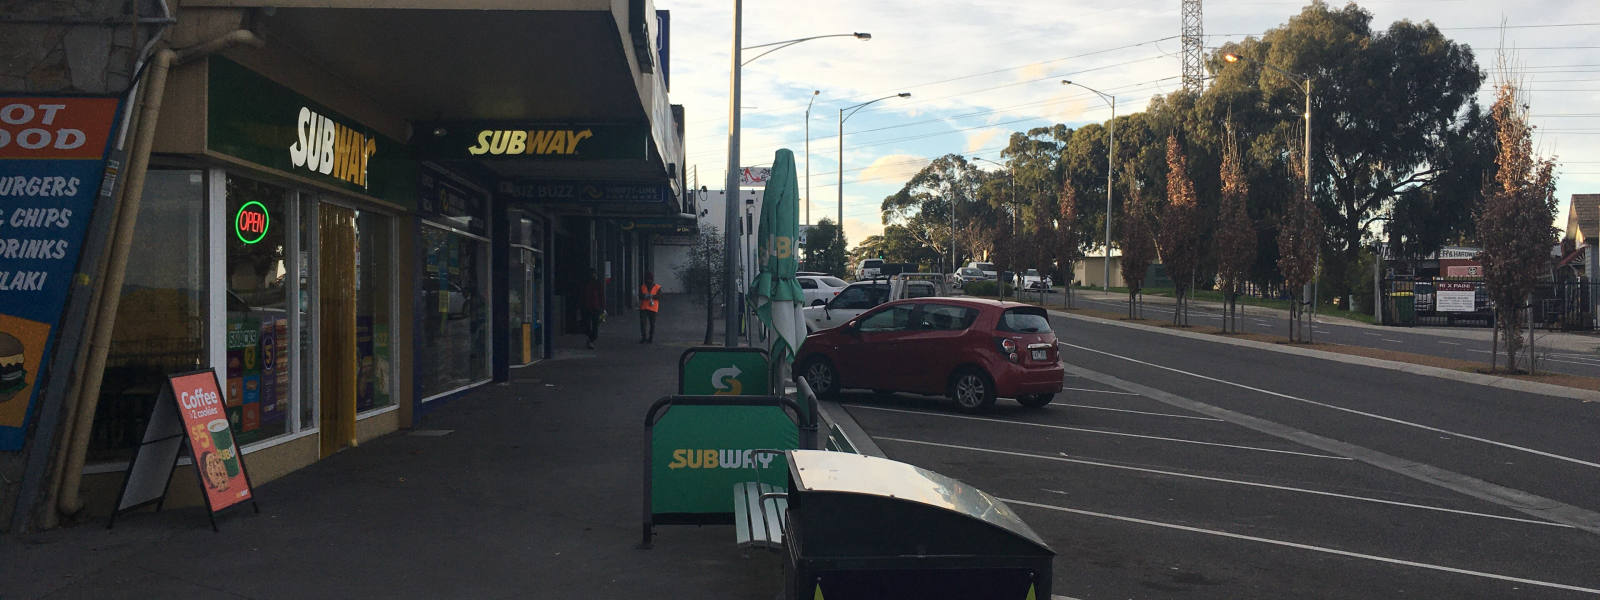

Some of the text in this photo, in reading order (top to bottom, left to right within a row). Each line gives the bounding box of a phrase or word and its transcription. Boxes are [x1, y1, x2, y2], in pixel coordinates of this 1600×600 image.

[289, 106, 377, 187] SUBWAY
[468, 129, 594, 156] SUBWAY
[10, 207, 73, 229] CHIPS
[239, 210, 265, 234] OPEN
[181, 388, 218, 409] Coffee
[197, 406, 218, 418] cookies
[668, 449, 776, 470] SUBWAY
